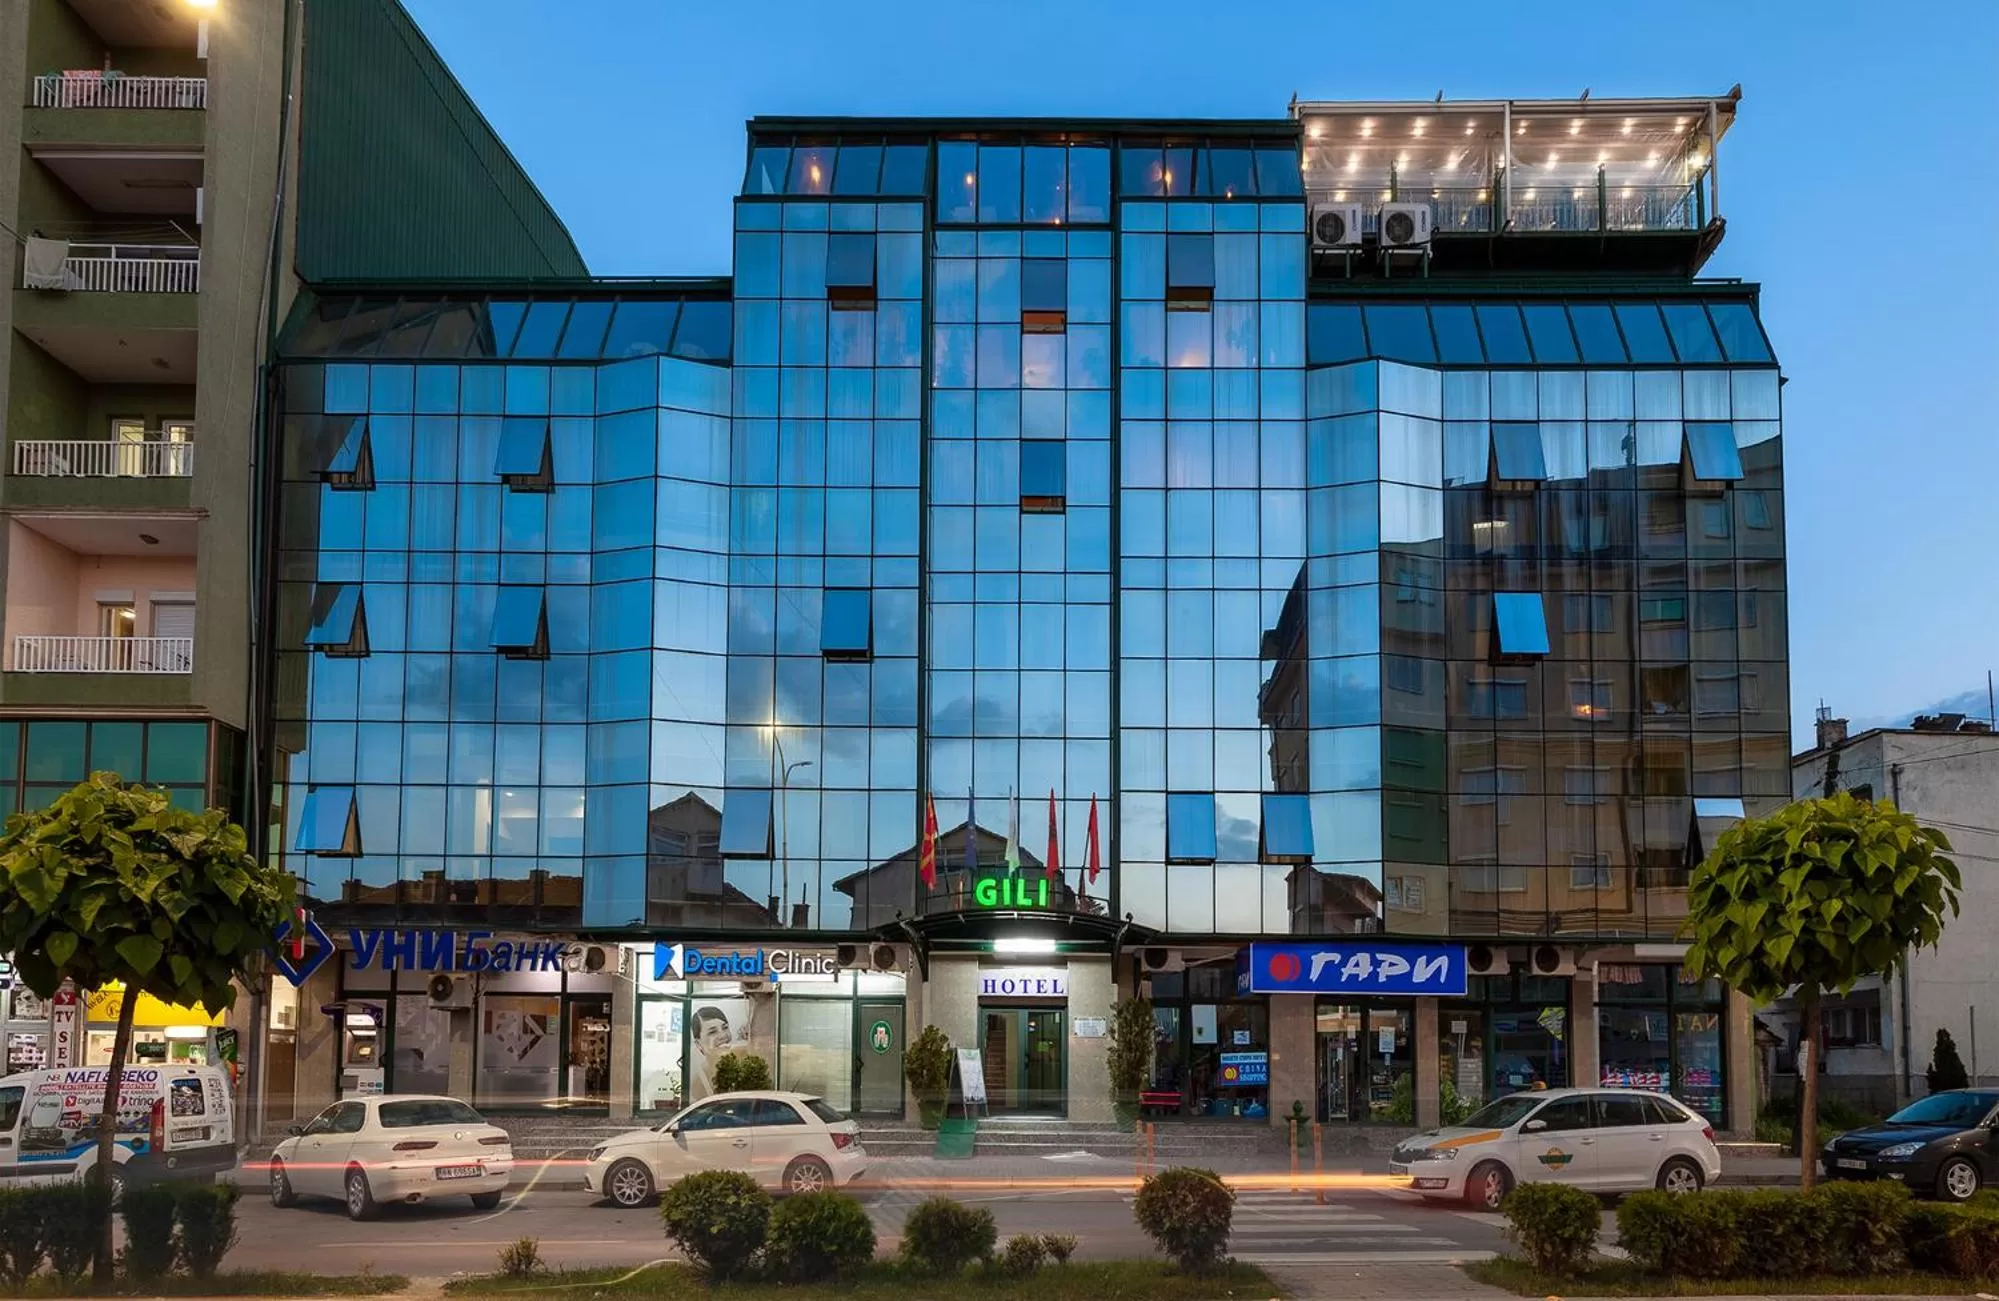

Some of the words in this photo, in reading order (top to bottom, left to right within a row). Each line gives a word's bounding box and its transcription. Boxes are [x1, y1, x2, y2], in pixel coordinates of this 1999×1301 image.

[975, 878, 1048, 906] GILI
[684, 948, 764, 975] Dental
[768, 949, 835, 974] Clinic
[1309, 951, 1449, 984] ГАРИ
[983, 978, 1064, 994] HOTEL
[55, 1011, 73, 1022] TV
[65, 1071, 101, 1083] NAFI
[121, 1070, 158, 1082] BEKO
